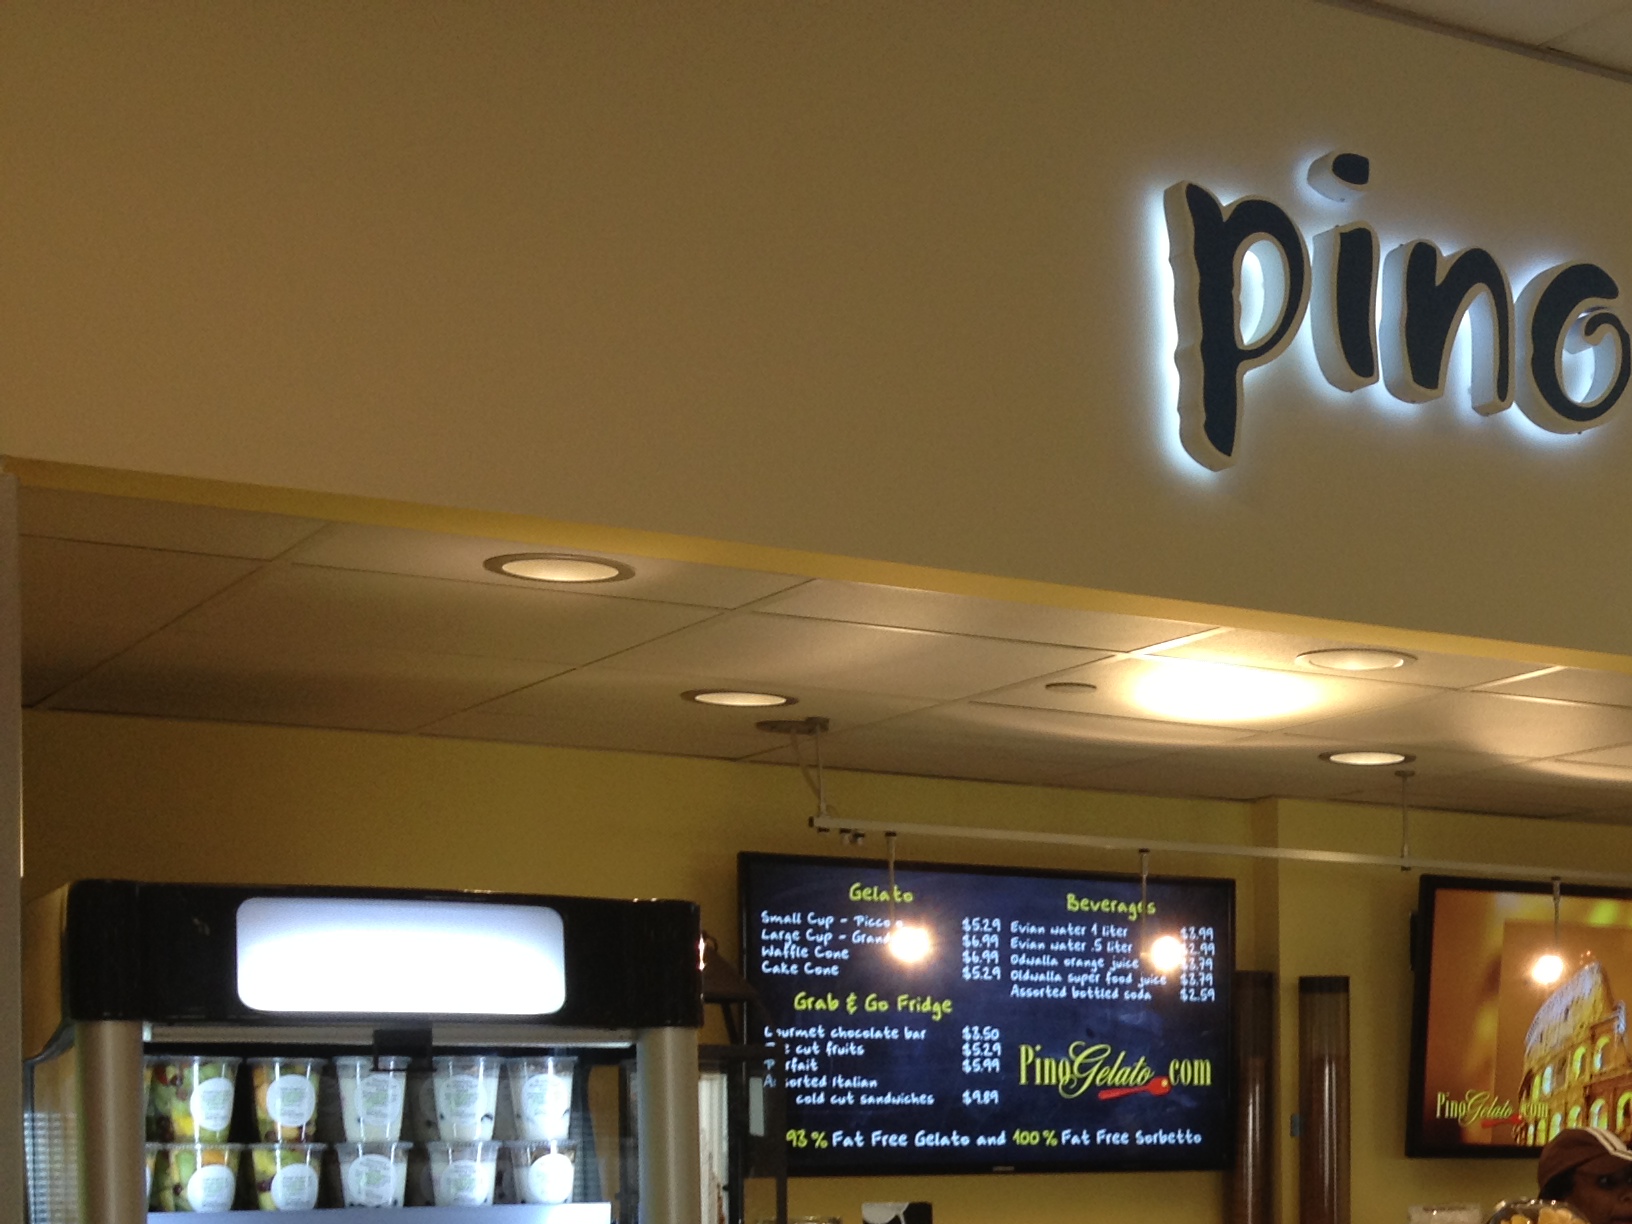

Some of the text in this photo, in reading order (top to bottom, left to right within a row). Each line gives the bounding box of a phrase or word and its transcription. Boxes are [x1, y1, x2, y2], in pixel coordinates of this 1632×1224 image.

[1168, 150, 1632, 468] pino
[849, 882, 914, 903] Gelato
[1066, 893, 1156, 921] Beverages
[761, 910, 801, 925] Small
[807, 912, 834, 929] Cup
[854, 914, 904, 928] Piccoo
[962, 917, 1001, 932] $5.29
[1010, 921, 1045, 935] Evian
[1050, 922, 1086, 936] water
[1102, 924, 1129, 938] liter
[761, 929, 800, 947] Large
[806, 929, 833, 946] Cup
[852, 930, 894, 945] Grand
[962, 933, 999, 949] $6.99
[1010, 937, 1045, 951] Evian
[1050, 938, 1086, 952] water
[1106, 940, 1133, 954] liter
[761, 944, 999, 965] Waffle Cone $6.99
[1010, 953, 1059, 967] Odwalla
[1063, 957, 1104, 972] orange
[1112, 955, 1139, 971] juice
[761, 960, 1001, 981] Cake Cone $5.29
[1067, 973, 1100, 987] super
[1106, 971, 1133, 985] food
[1138, 973, 1168, 988] juice
[1010, 984, 1215, 1002] Assorted bottled soda $2.59
[793, 991, 953, 1021] Grab & Go Fridge
[830, 1026, 899, 1040] chocolate
[904, 1027, 926, 1040] bar
[795, 1042, 820, 1055] cut
[826, 1041, 865, 1056] fruits
[961, 1042, 1002, 1057] $5.29
[763, 1057, 1000, 1074] Prfait $5.99
[763, 1074, 878, 1088] Aorted Italian
[796, 1092, 825, 1105] cold
[830, 1093, 855, 1105] cut
[860, 1092, 935, 1107] sandwiches
[832, 1130, 865, 1147] Fat
[871, 1130, 908, 1147] Free
[914, 1130, 970, 1147] Gelato
[976, 1130, 1006, 1147] and
[1061, 1129, 1090, 1146] Fat
[1096, 1128, 1130, 1145] Free
[1135, 1128, 1202, 1145] Sorbetto
